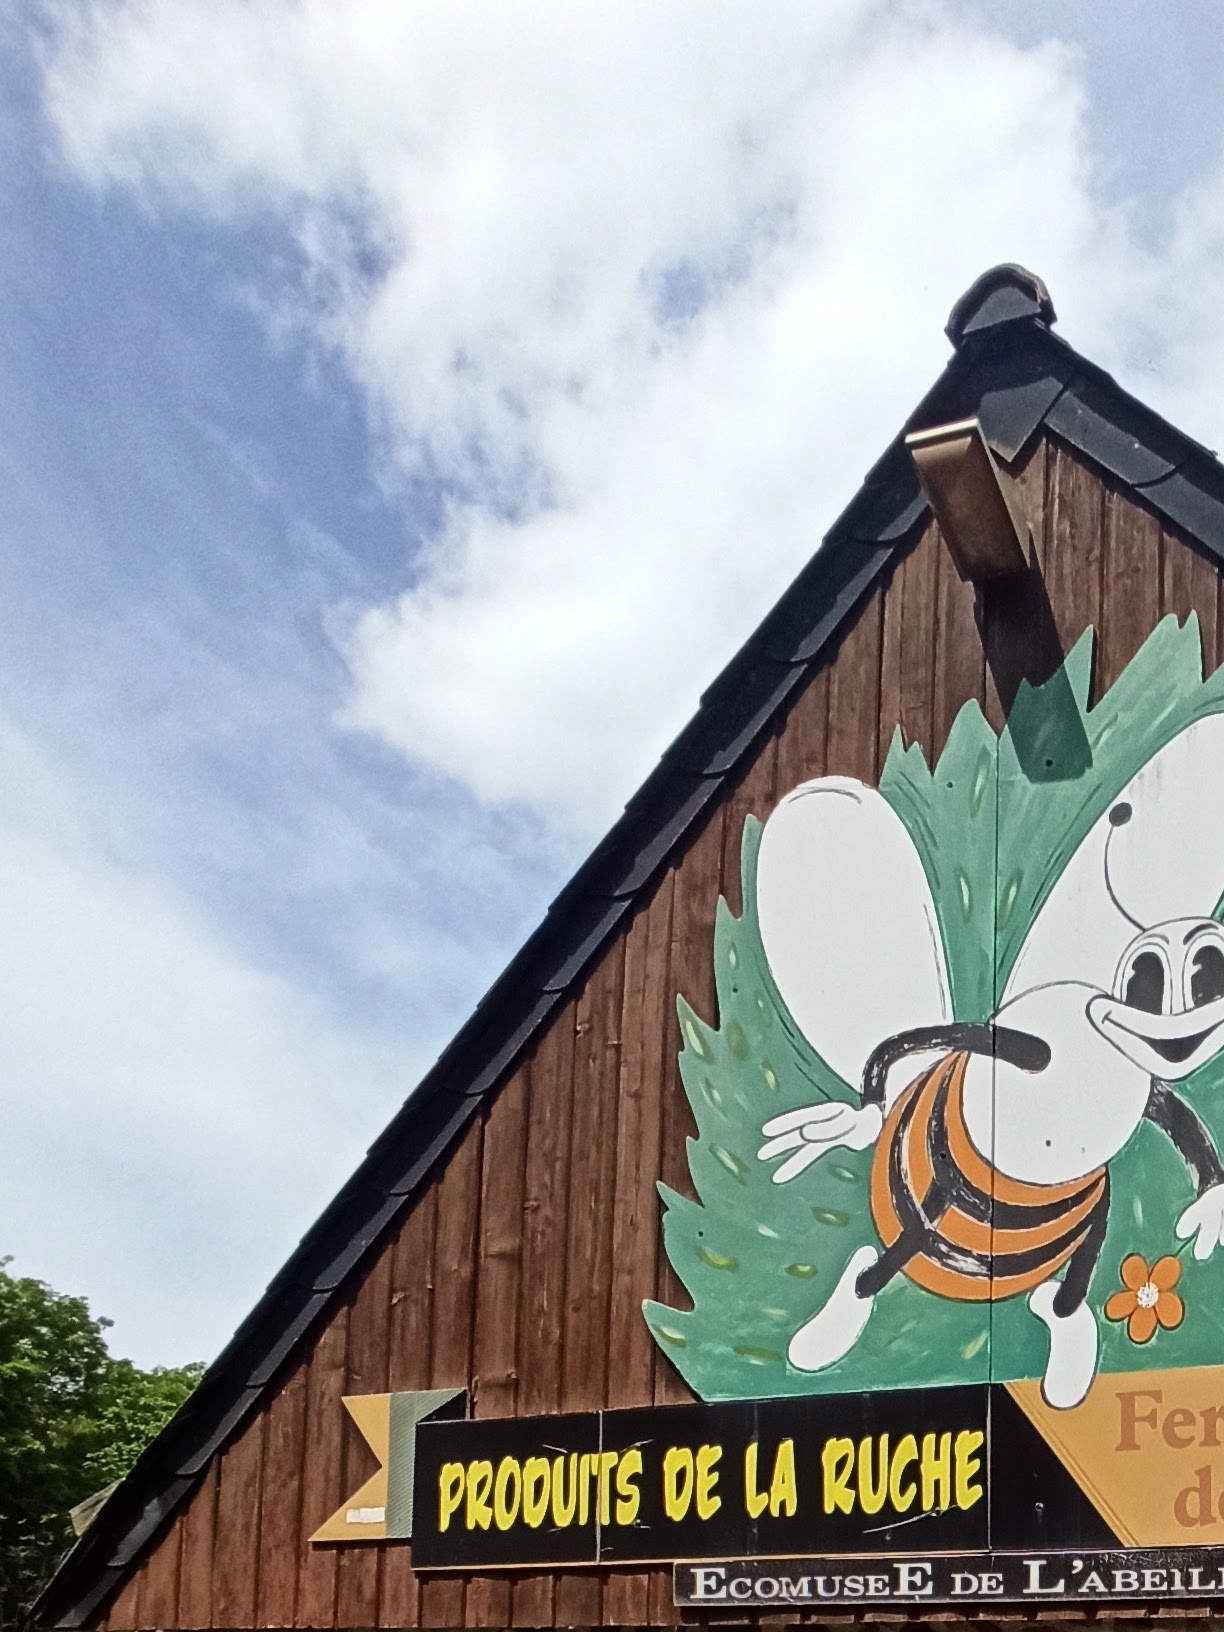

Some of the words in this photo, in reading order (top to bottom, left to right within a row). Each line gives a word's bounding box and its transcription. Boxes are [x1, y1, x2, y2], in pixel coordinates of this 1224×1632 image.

[438, 1449, 643, 1533] PRODUITS
[663, 1444, 723, 1521] DE
[745, 1439, 798, 1517] LA
[822, 1430, 985, 1514] RUCHE
[951, 1573, 1004, 1595] DE
